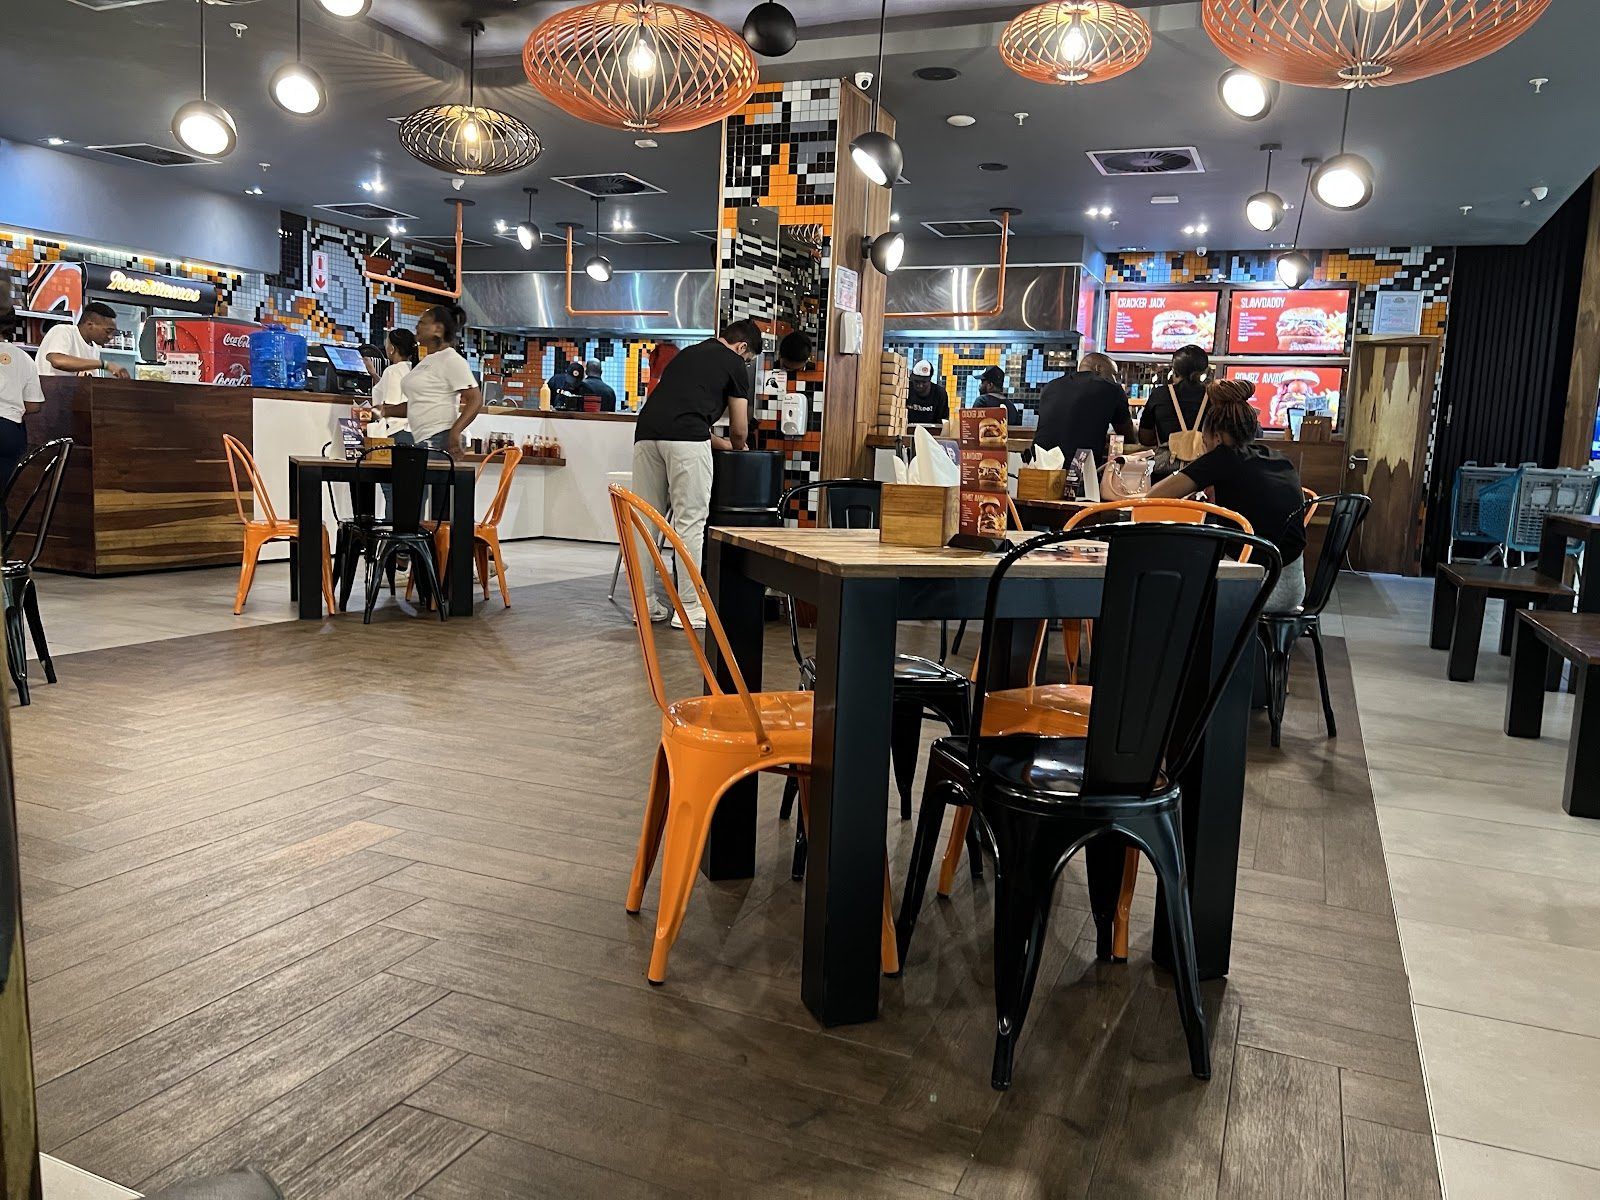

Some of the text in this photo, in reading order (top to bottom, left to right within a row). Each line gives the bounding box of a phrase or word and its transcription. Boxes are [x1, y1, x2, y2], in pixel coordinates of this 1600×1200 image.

[1117, 297, 1167, 309] CRACKER JACK
[1240, 297, 1286, 309] SLAWDADDY
[1262, 372, 1285, 384] AWAY
